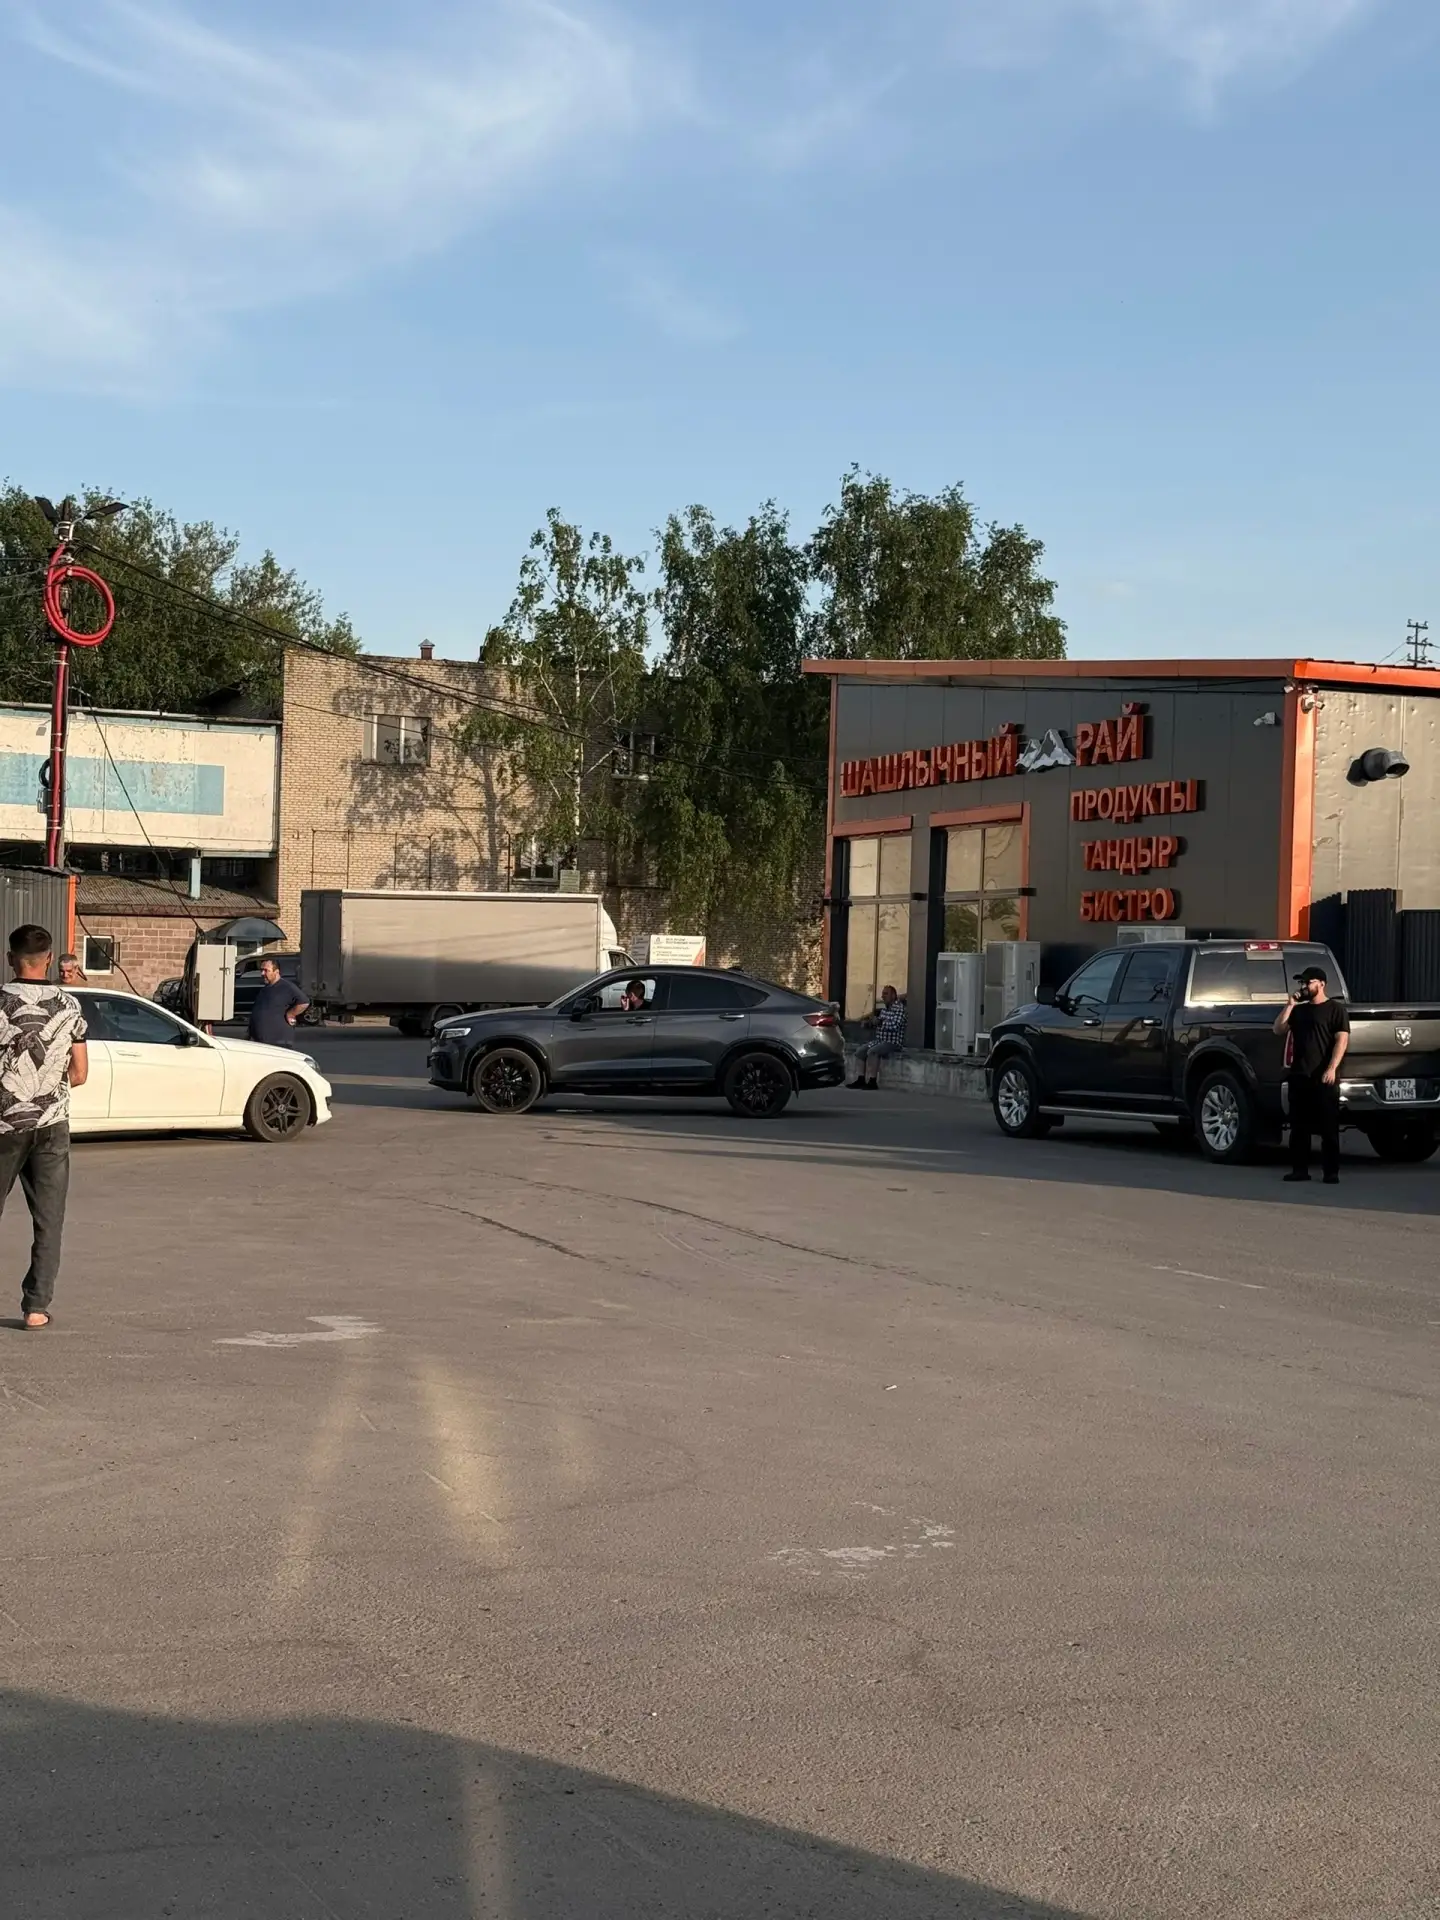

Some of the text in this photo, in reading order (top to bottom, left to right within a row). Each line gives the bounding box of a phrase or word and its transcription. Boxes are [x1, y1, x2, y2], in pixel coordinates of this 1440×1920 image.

[840, 702, 1144, 797] ШАШЛЫЧНЫЙ РАЙ
[1070, 780, 1198, 823] ПРОДУКТЫ
[1080, 836, 1177, 875] ТАНДЫР
[1080, 888, 1174, 922] БИСТРО
